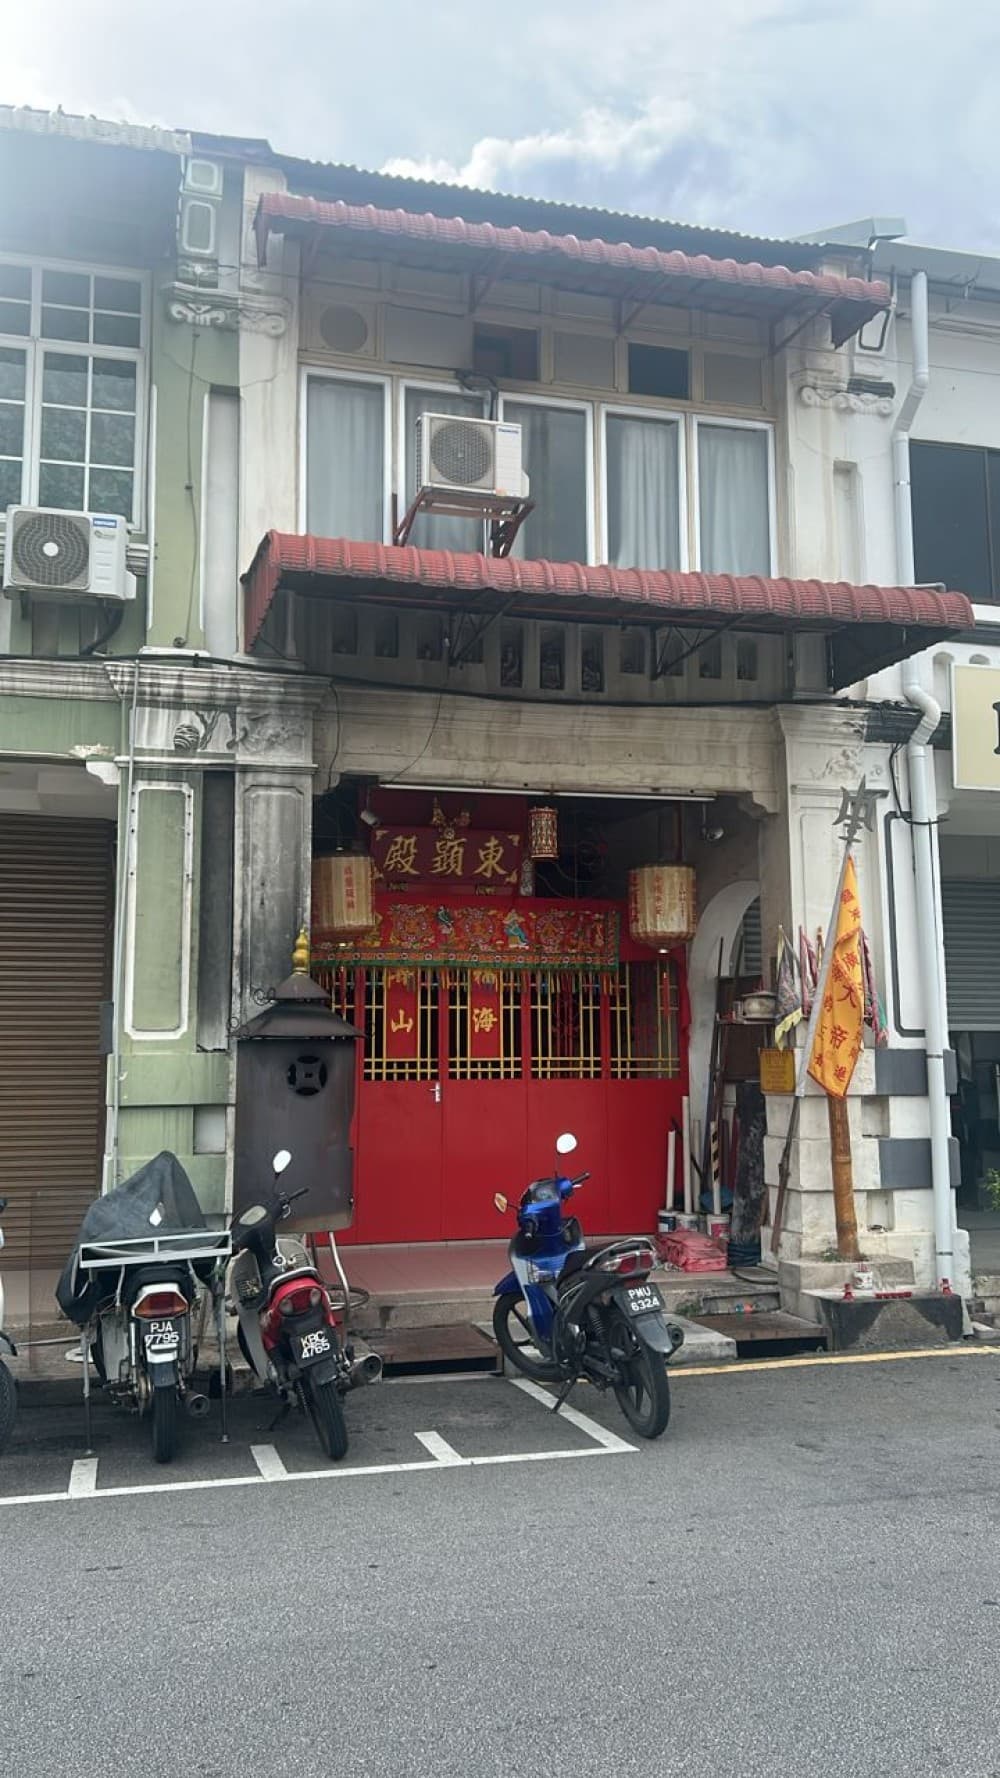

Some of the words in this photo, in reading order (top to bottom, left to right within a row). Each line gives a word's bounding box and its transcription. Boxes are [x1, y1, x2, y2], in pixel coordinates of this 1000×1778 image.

[627, 1285, 651, 1300] PMU
[631, 1295, 661, 1312] 6324
[150, 1320, 174, 1333] PJA
